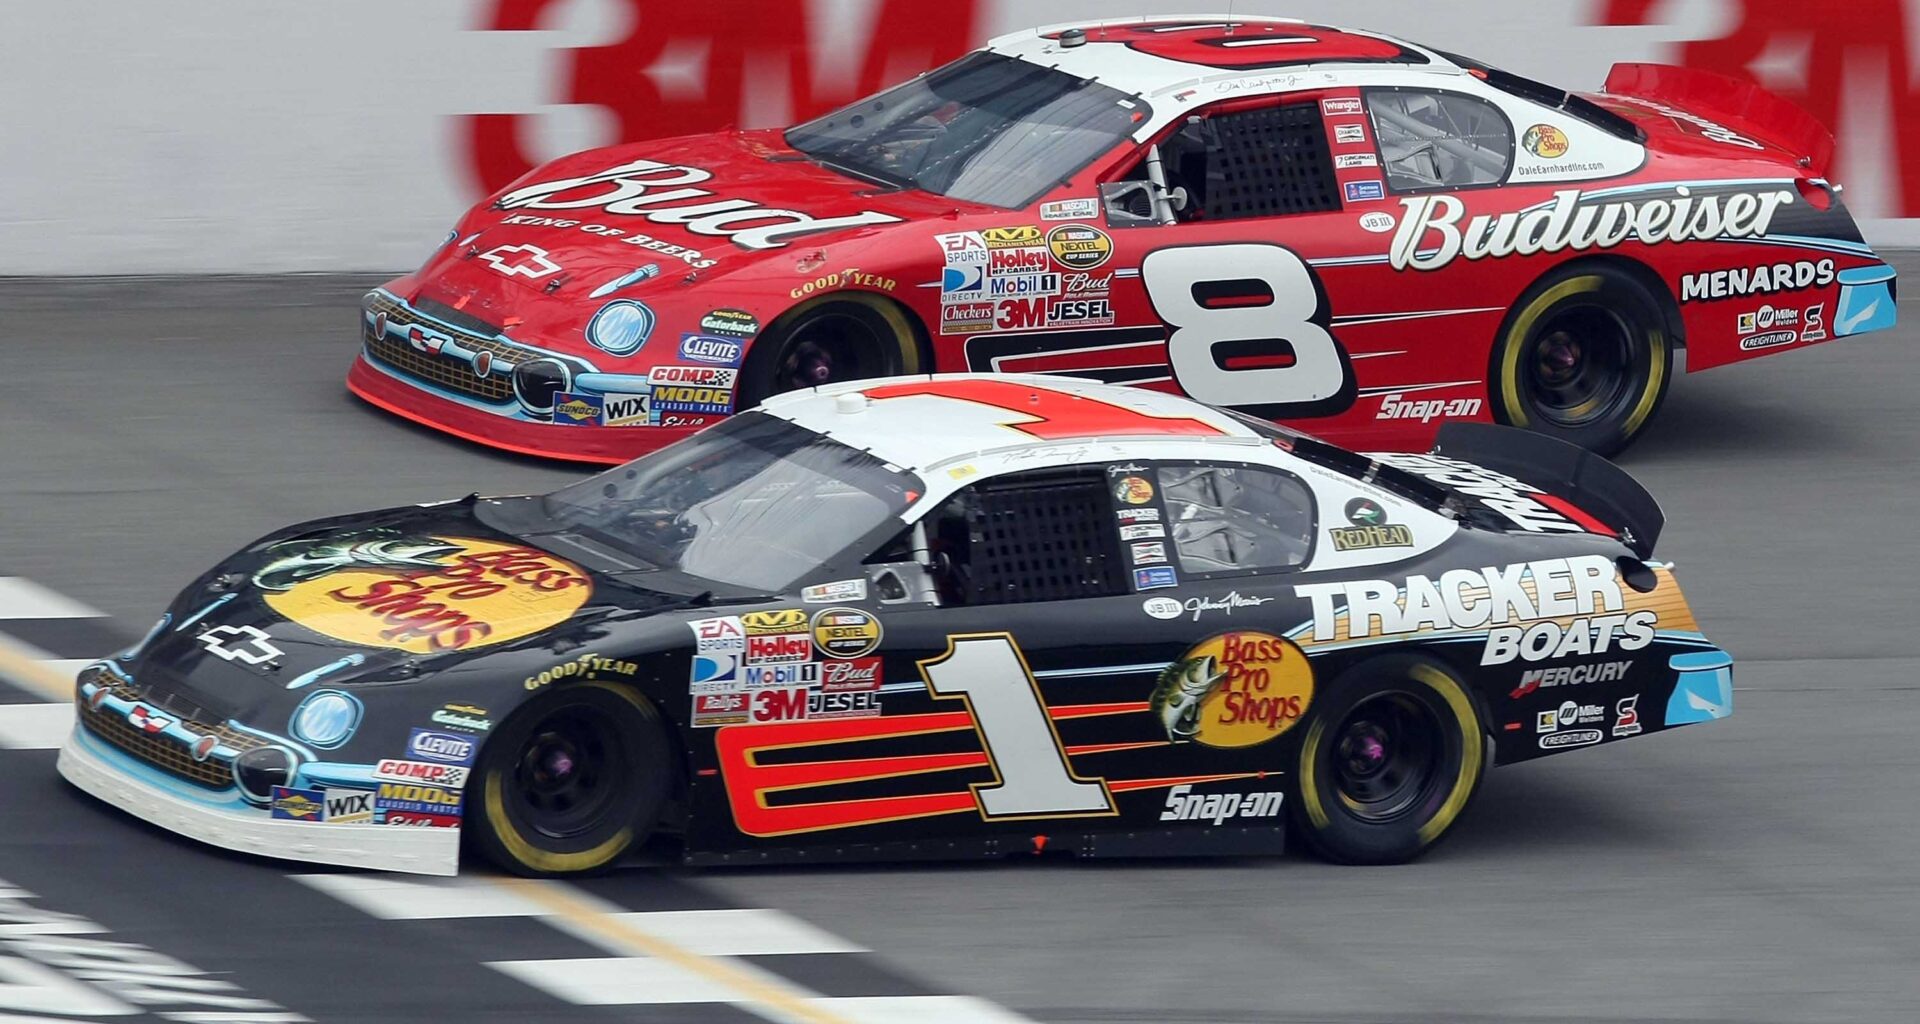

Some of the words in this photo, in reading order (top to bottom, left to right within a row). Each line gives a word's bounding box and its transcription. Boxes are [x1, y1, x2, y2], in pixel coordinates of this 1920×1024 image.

[1325, 101, 1360, 112] Wrangler
[499, 159, 905, 250] Bud
[1389, 185, 1794, 272] Budweiser
[502, 213, 580, 228] KING
[580, 224, 626, 237] OF
[619, 234, 718, 269] BEERS
[946, 235, 983, 251] EA
[1060, 241, 1100, 251] NEXTEL
[947, 250, 987, 263] SPORTS
[991, 249, 1047, 272] Holley
[1065, 252, 1078, 260] CUP
[1006, 266, 1038, 274] CARBS
[1681, 258, 1835, 301] MENARDS
[991, 276, 1036, 294] Mobil
[1063, 272, 1113, 292] Bud
[942, 292, 983, 302] DIRECTV
[944, 304, 992, 321] Checkers
[997, 298, 1046, 329] 3M
[1047, 301, 1111, 321] JESEL
[1775, 308, 1799, 320] Miller
[701, 316, 759, 333] Gatorback
[1142, 243, 1344, 407] 8
[683, 336, 738, 358] CLEVITE
[1743, 332, 1793, 347] FREIGHTLINER
[652, 368, 715, 382] COMP
[653, 387, 732, 405] MOOG
[558, 403, 600, 416] SUNOCO
[606, 396, 648, 420] WIX
[655, 401, 694, 410] CHASSIS
[700, 404, 729, 413] PARTS
[1376, 394, 1482, 423] Snap-on
[1294, 555, 1624, 641] TRACKER
[699, 620, 741, 638] EA
[826, 627, 868, 638] NEXTEL
[1480, 611, 1658, 666] BOATS
[700, 637, 744, 651] SPORTS
[750, 636, 809, 661] Holley
[1219, 633, 1283, 664] Bass
[745, 666, 796, 685] Mobil
[824, 662, 880, 683] Bud
[1219, 663, 1269, 693] Pro
[1519, 660, 1633, 689] MERCURY
[753, 688, 808, 722] 3M
[809, 691, 880, 713] JESEL
[1218, 691, 1301, 729] Shops
[1579, 704, 1605, 715] Miller
[920, 633, 1116, 819] 1
[1544, 731, 1598, 746] FREIGHTLINER
[381, 762, 444, 779] COMP
[378, 783, 462, 805] MOOG
[327, 793, 371, 818] WIX
[1160, 785, 1284, 826] Snap-on
